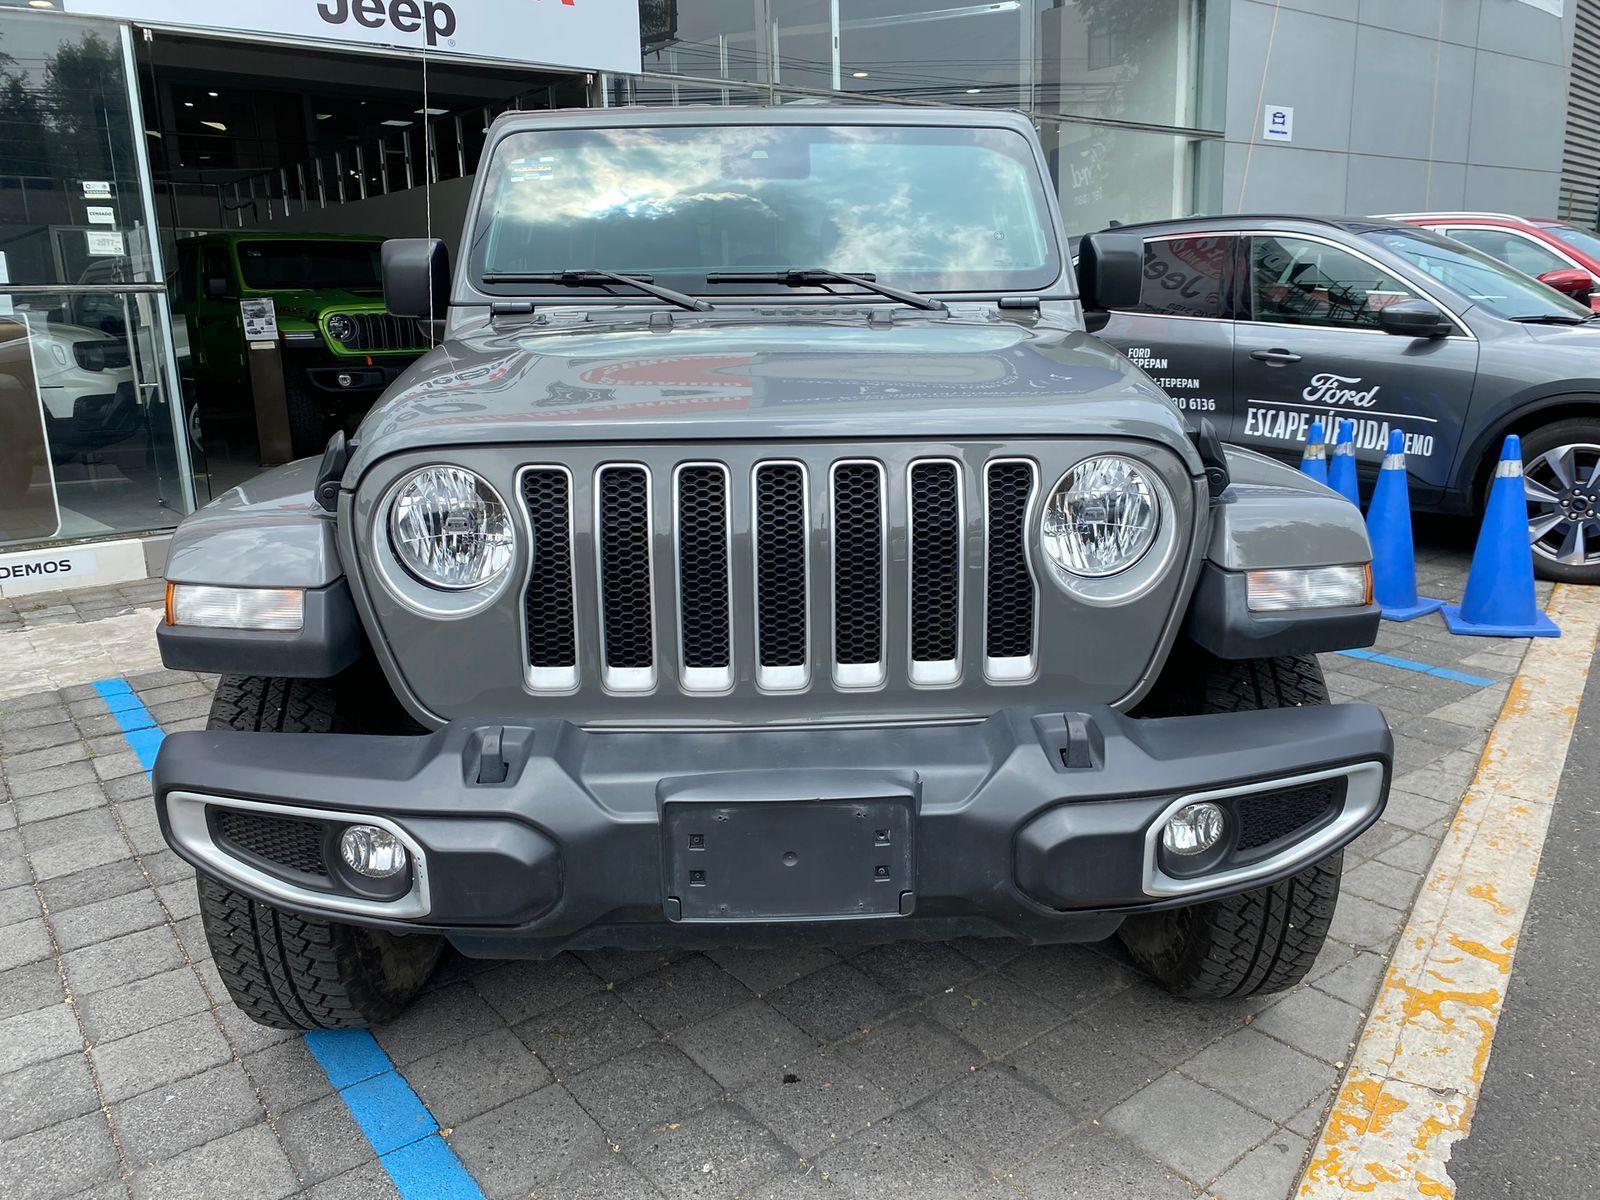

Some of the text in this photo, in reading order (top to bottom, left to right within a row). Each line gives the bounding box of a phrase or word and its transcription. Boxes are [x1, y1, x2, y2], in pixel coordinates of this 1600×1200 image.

[317, 0, 457, 46] Jeep
[1128, 348, 1151, 358] FORD
[1129, 359, 1168, 369] EPEPAN
[1302, 373, 1381, 408] Ford
[1189, 398, 1216, 411] 6136
[1243, 408, 1310, 442] ESCAPE
[1402, 432, 1434, 457] EMO
[0, 559, 72, 579] DEMOS
